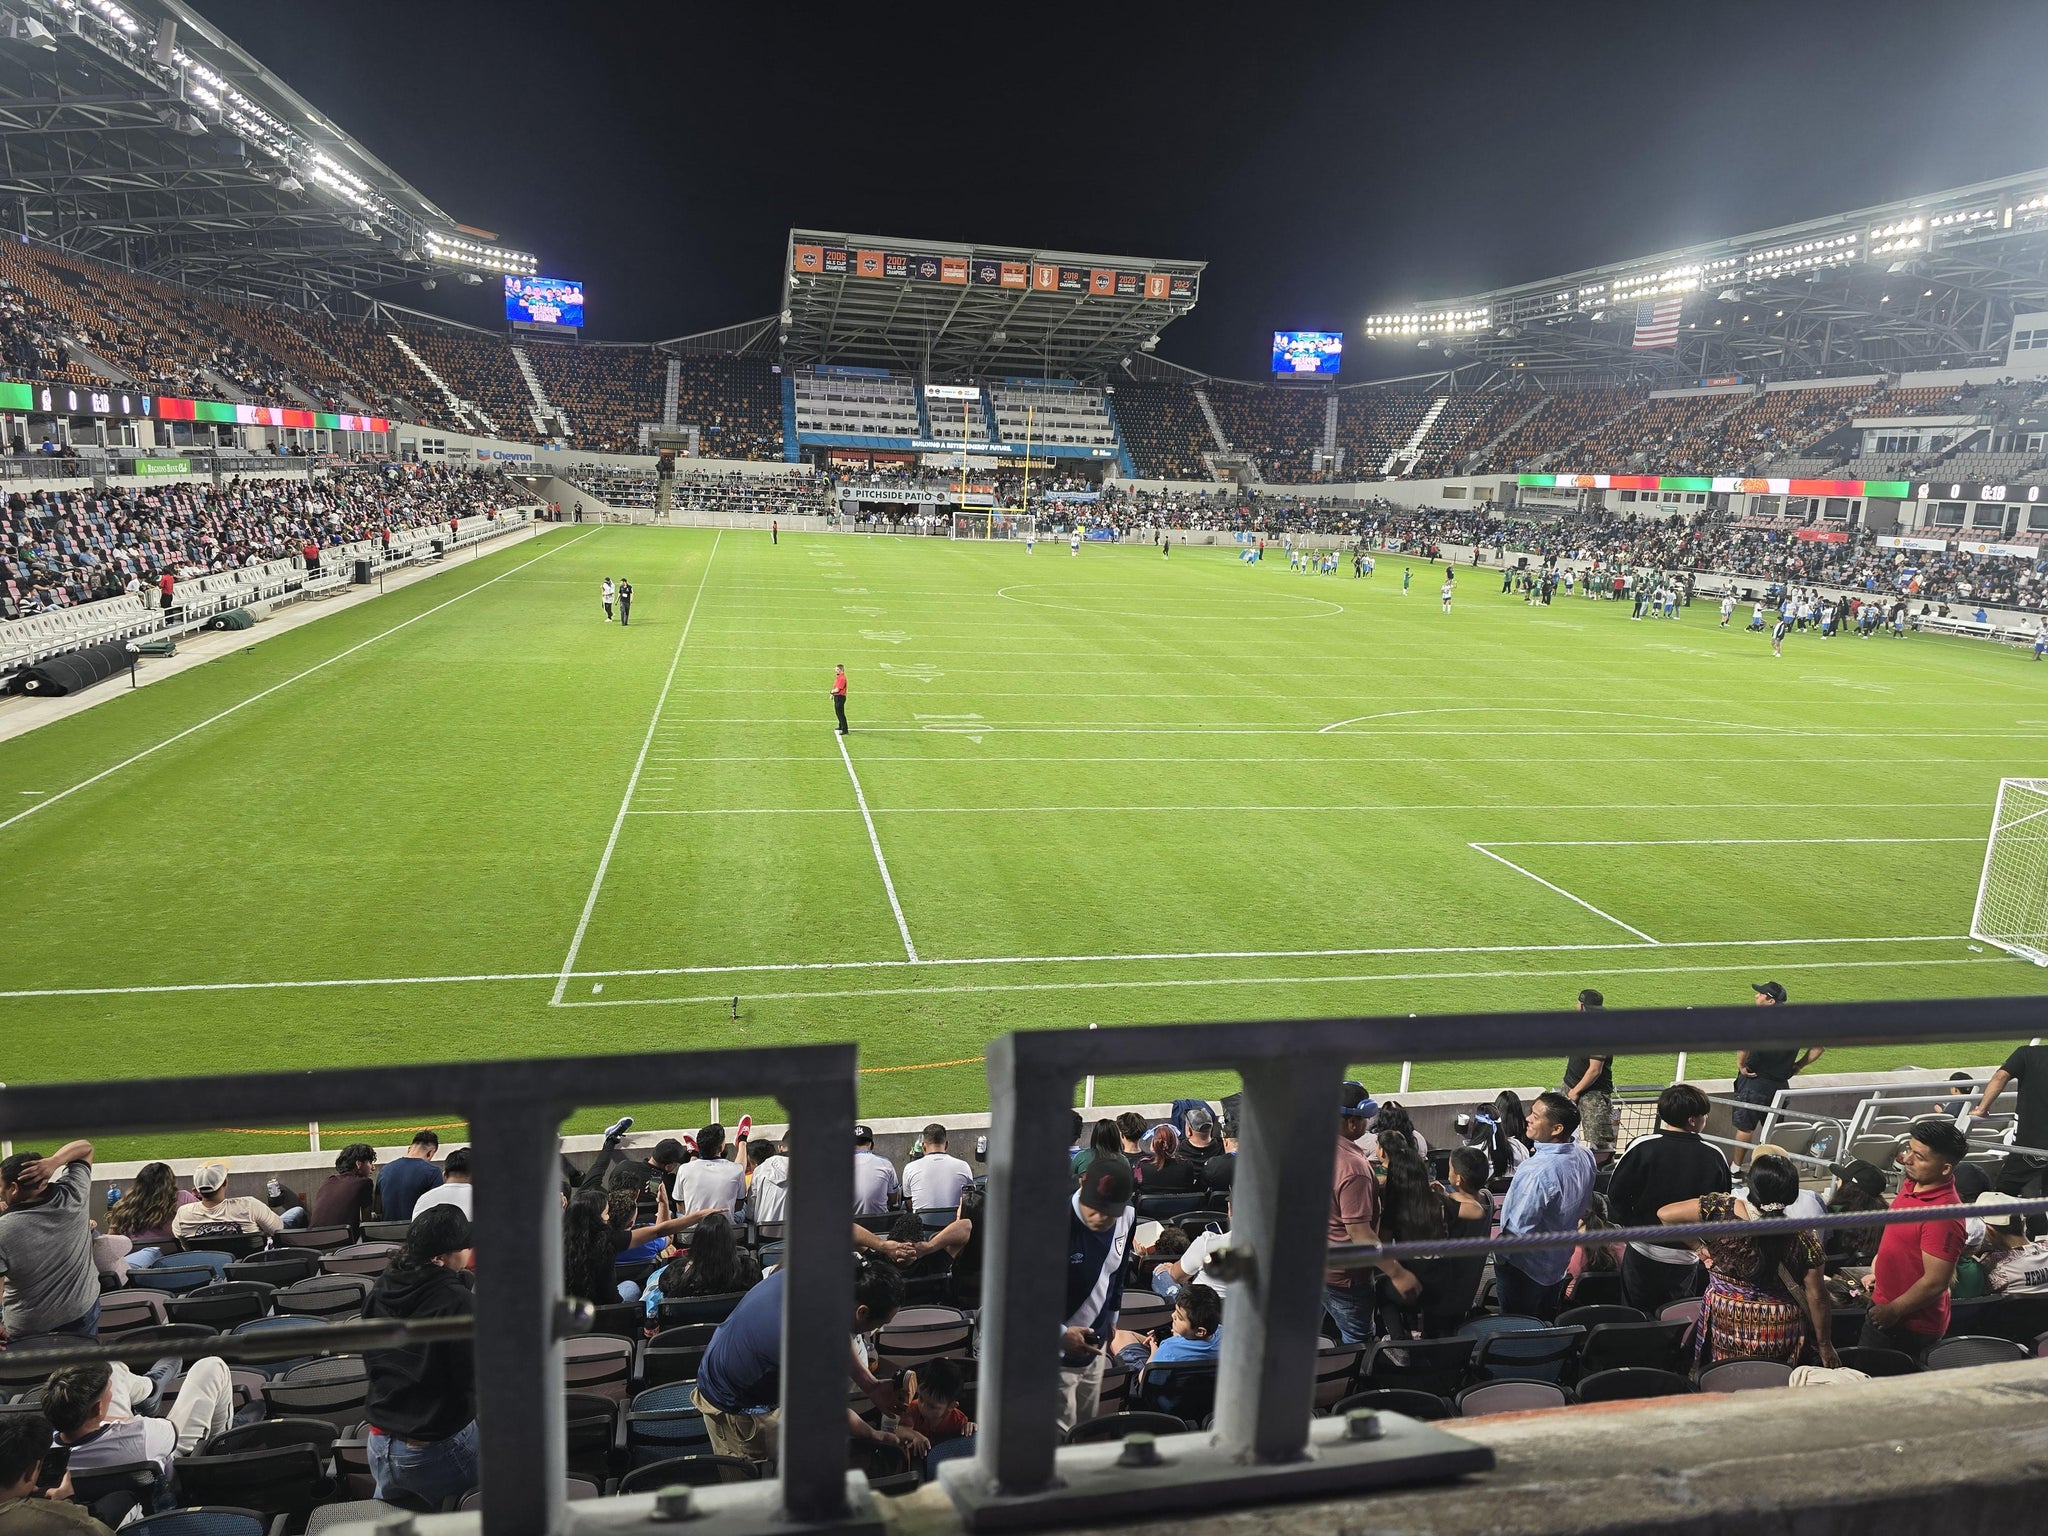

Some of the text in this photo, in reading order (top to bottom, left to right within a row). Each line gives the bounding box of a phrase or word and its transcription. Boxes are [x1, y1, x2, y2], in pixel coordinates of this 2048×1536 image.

[826, 252, 846, 261] 2006
[887, 256, 906, 265] 2007
[1063, 272, 1078, 280] 2018
[1120, 276, 1136, 284] 2020
[69, 390, 77, 411] 0
[122, 396, 130, 414] 0
[493, 451, 532, 460] Chevron
[856, 490, 902, 500] PITCHSIDE
[1950, 484, 1960, 499] 0
[1981, 485, 2006, 500] 6:18
[2028, 486, 2039, 502] 0
